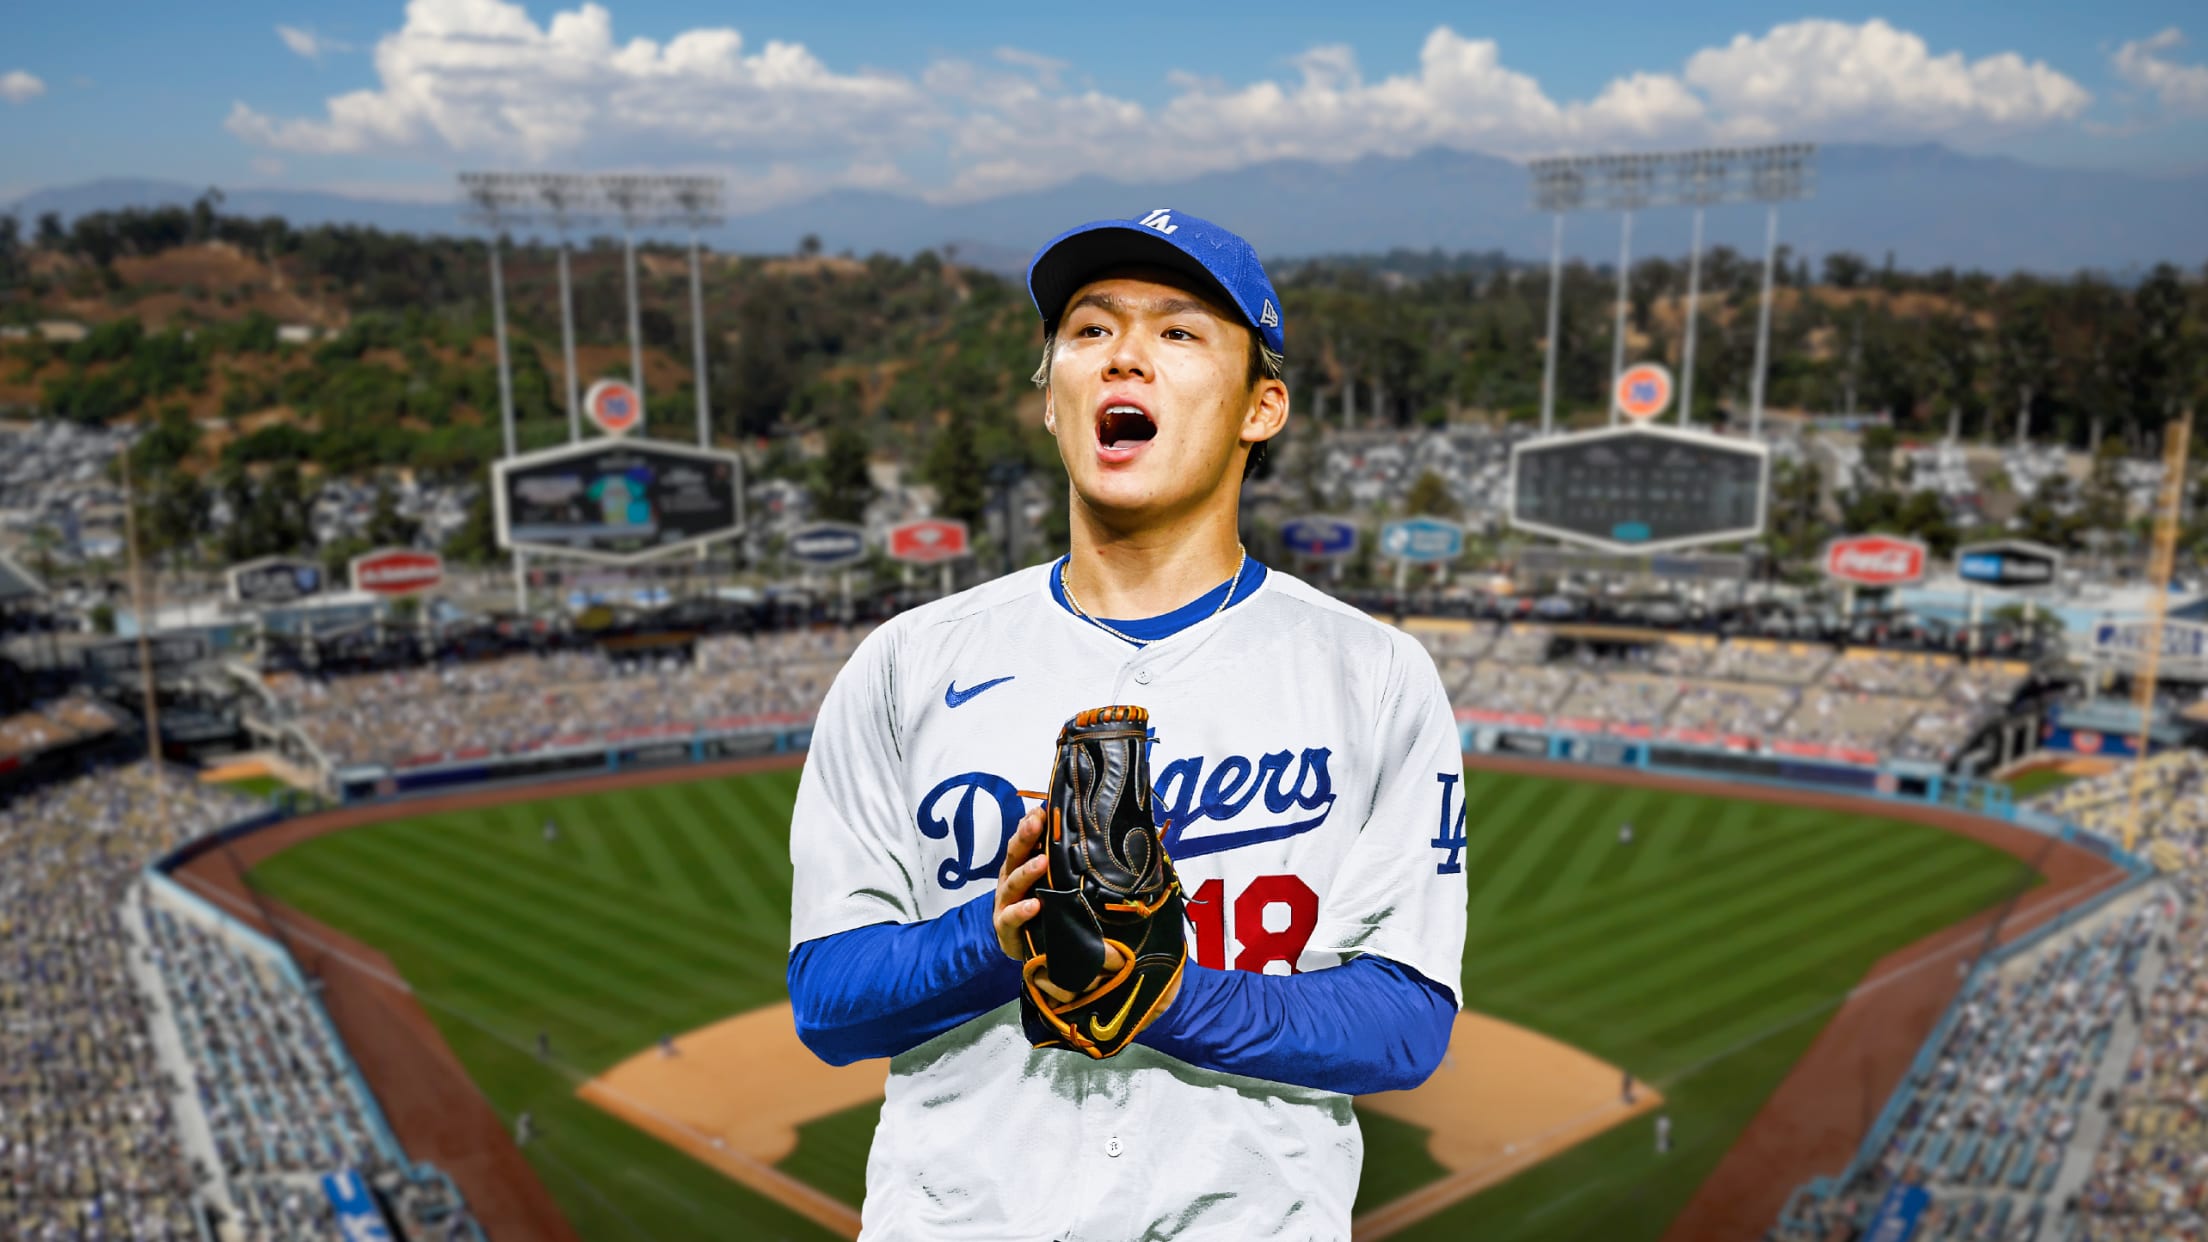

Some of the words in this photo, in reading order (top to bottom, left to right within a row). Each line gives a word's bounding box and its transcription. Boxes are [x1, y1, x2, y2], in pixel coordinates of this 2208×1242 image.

[1138, 208, 1179, 235] LA
[917, 727, 1337, 890] Dgers
[1185, 874, 1320, 977] 18
